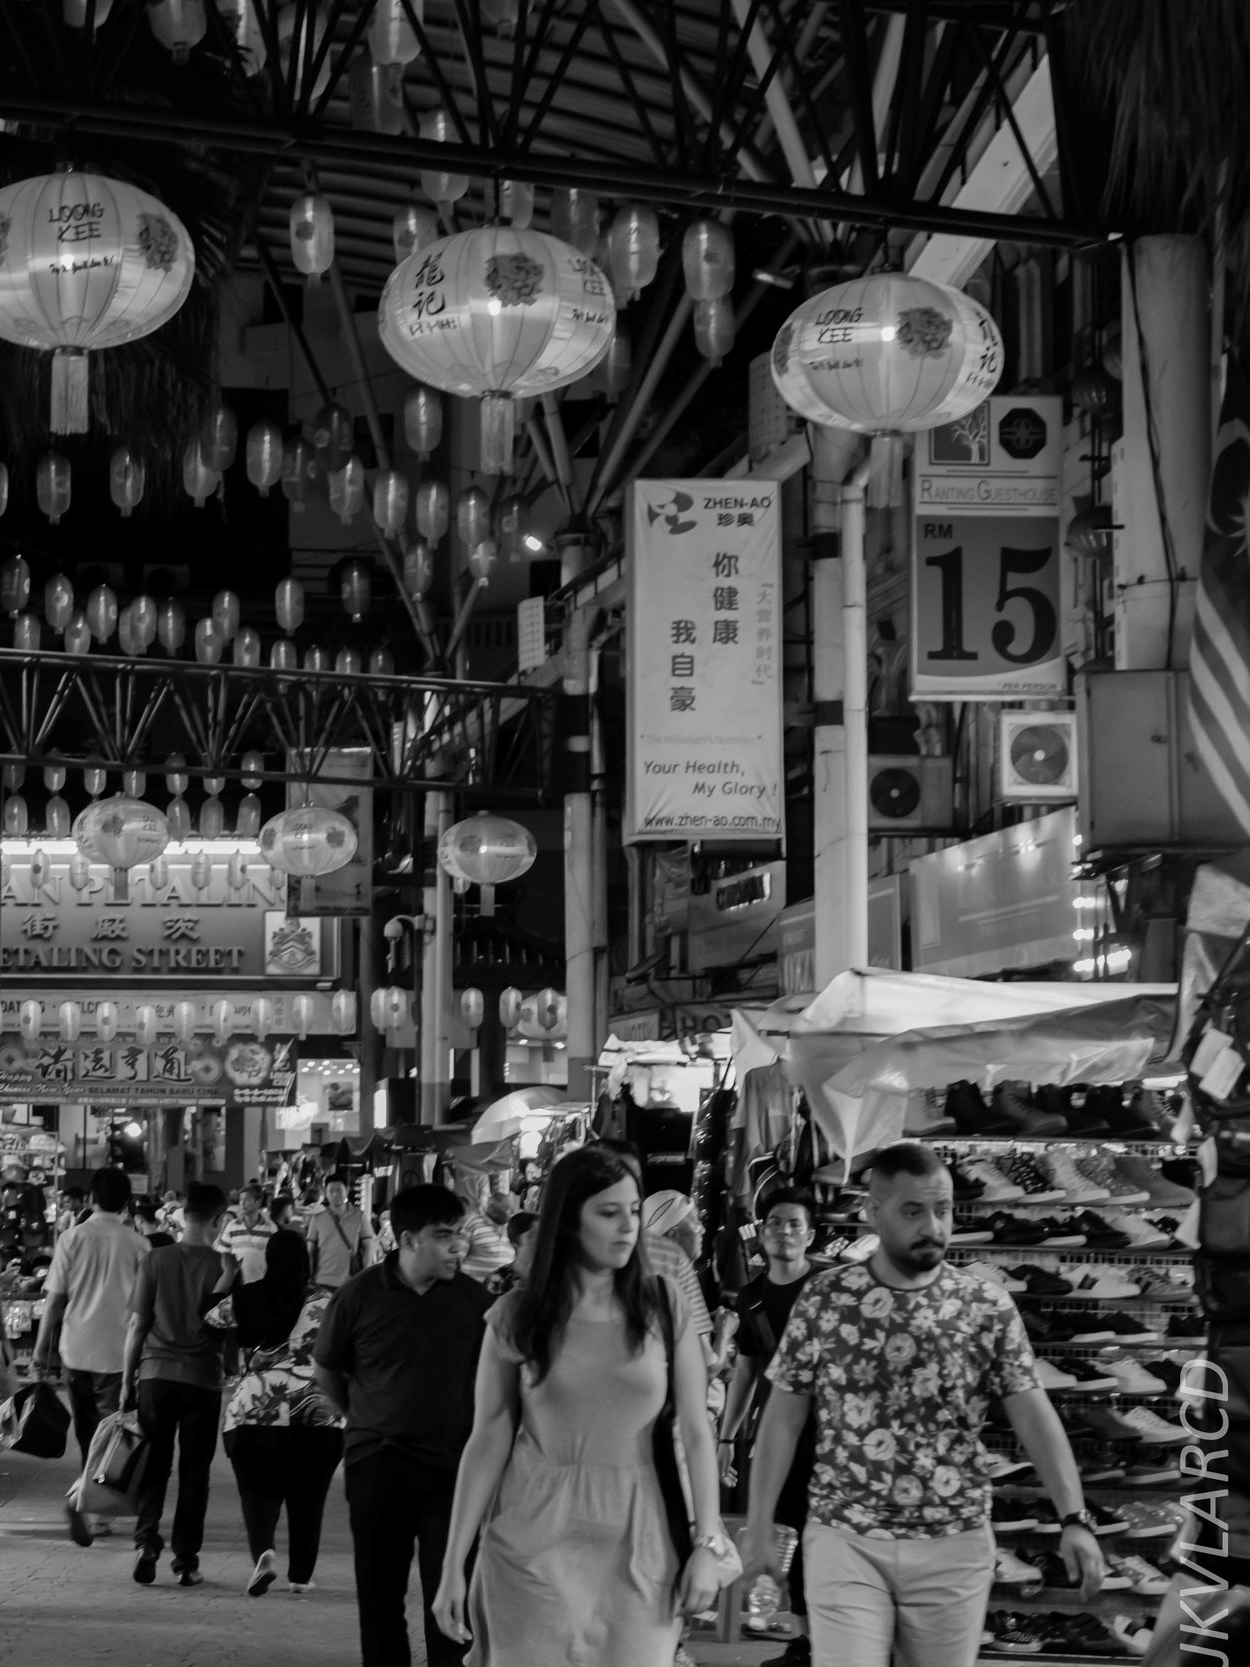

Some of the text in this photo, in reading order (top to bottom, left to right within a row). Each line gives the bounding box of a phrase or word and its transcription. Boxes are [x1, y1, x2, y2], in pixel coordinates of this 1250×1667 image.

[48, 203, 105, 223] LOONG
[57, 221, 101, 243] KEE
[814, 306, 864, 326] LOONG
[817, 326, 855, 344] KEE
[703, 497, 771, 509] ZHEN-AO
[924, 523, 953, 539] RM
[713, 552, 739, 645] 你健康
[925, 546, 1056, 665] 15
[670, 618, 696, 712] 我自豪
[643, 760, 746, 777] Your Health,
[692, 781, 717, 798] My
[721, 781, 767, 799] Glory
[644, 811, 782, 833] www.zhen-ao.com.my
[0, 946, 244, 969] ETALING STREET
